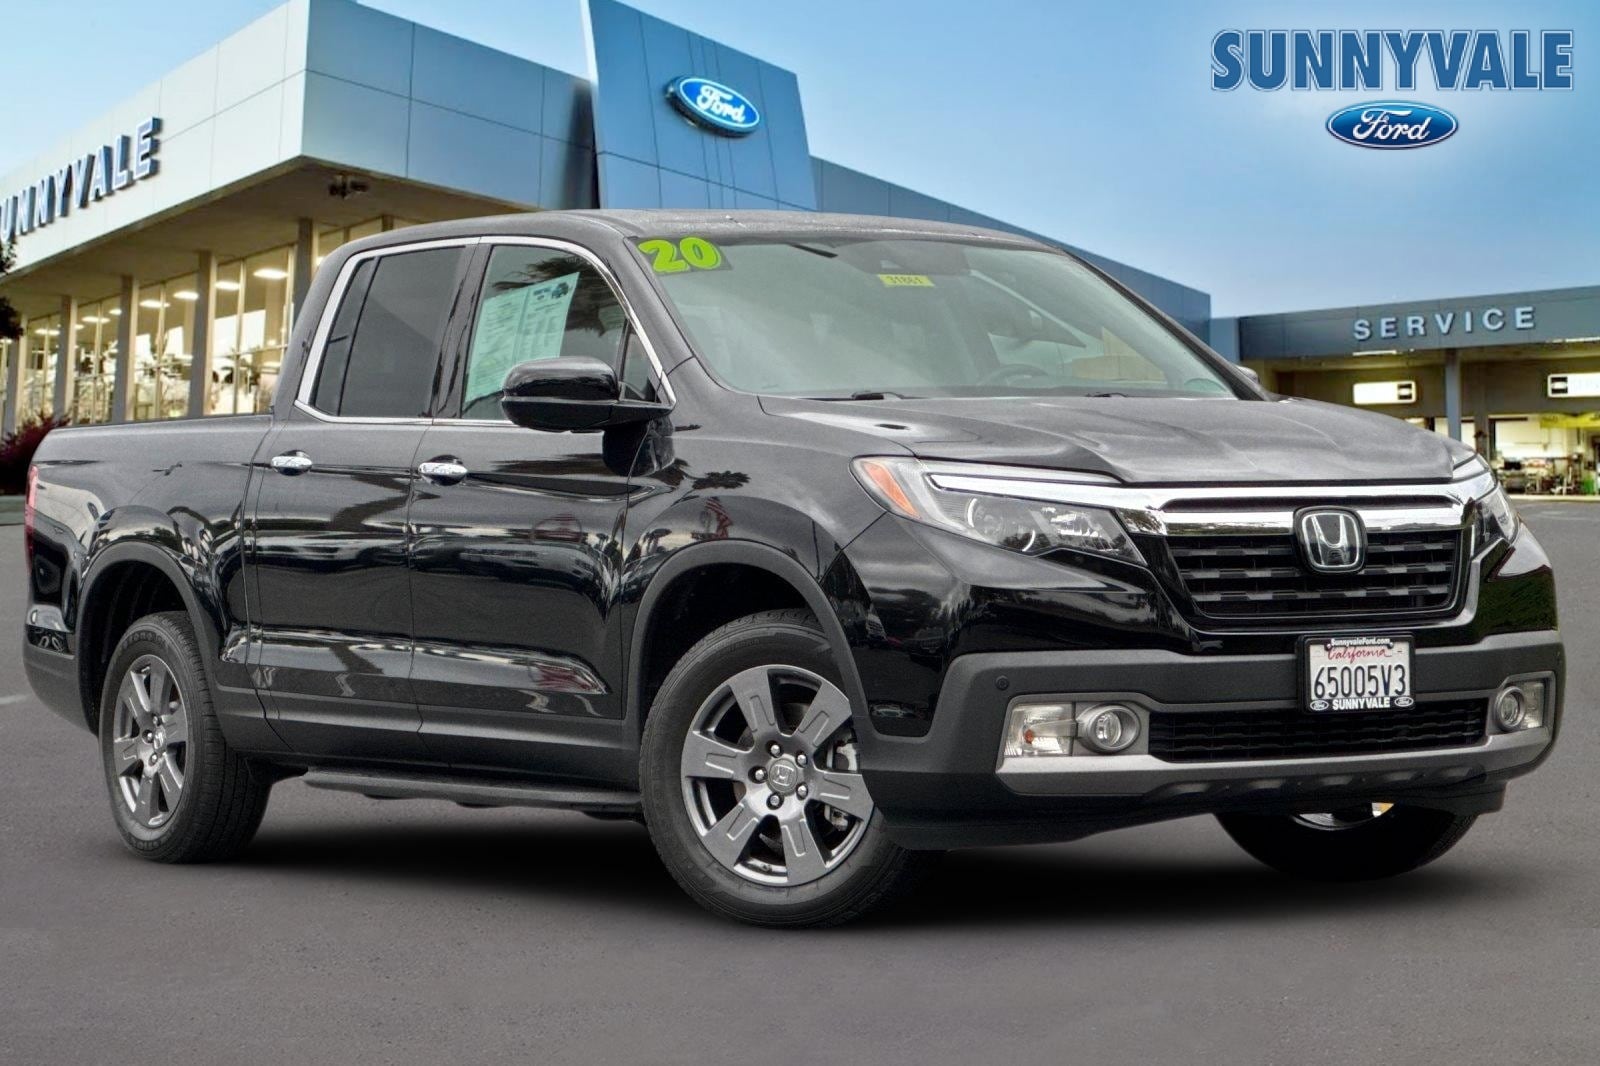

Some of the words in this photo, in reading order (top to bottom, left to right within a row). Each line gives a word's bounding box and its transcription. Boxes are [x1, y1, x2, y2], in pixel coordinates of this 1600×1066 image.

[696, 85, 746, 122] Ford
[0, 117, 162, 243] UNNYVALE
[638, 237, 722, 273] 20
[1353, 306, 1535, 341] SERVICE
[1328, 647, 1392, 663] California
[1314, 664, 1406, 698] 65005V3
[1332, 697, 1391, 710] SUNNYVALE
